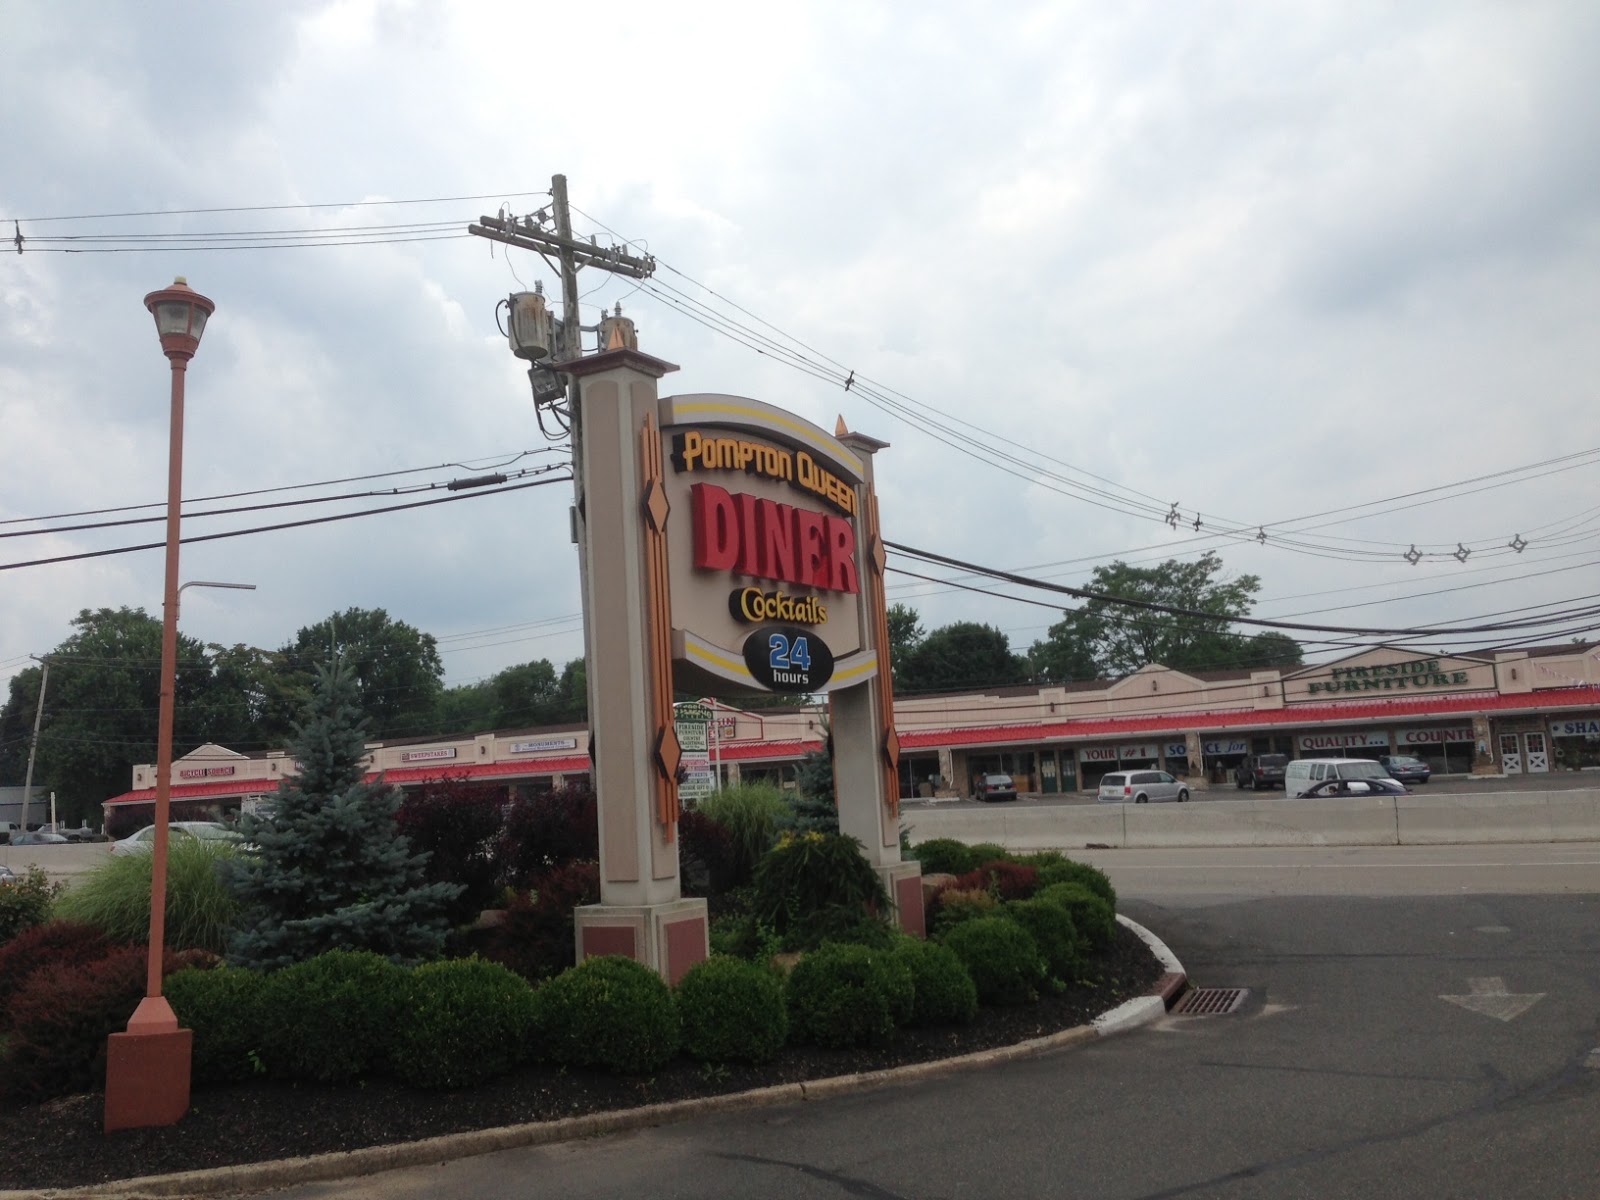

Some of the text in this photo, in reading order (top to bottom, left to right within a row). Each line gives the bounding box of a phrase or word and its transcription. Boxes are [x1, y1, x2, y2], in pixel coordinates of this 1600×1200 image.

[691, 482, 860, 593] DINER
[740, 586, 828, 624] Cocktails
[769, 633, 811, 671] 24
[773, 669, 810, 685] hours
[1331, 660, 1440, 679] FIRESIDE
[1308, 672, 1469, 694] FURNITURE
[1405, 729, 1475, 743] COUNTR
[1085, 749, 1116, 760] YOUR
